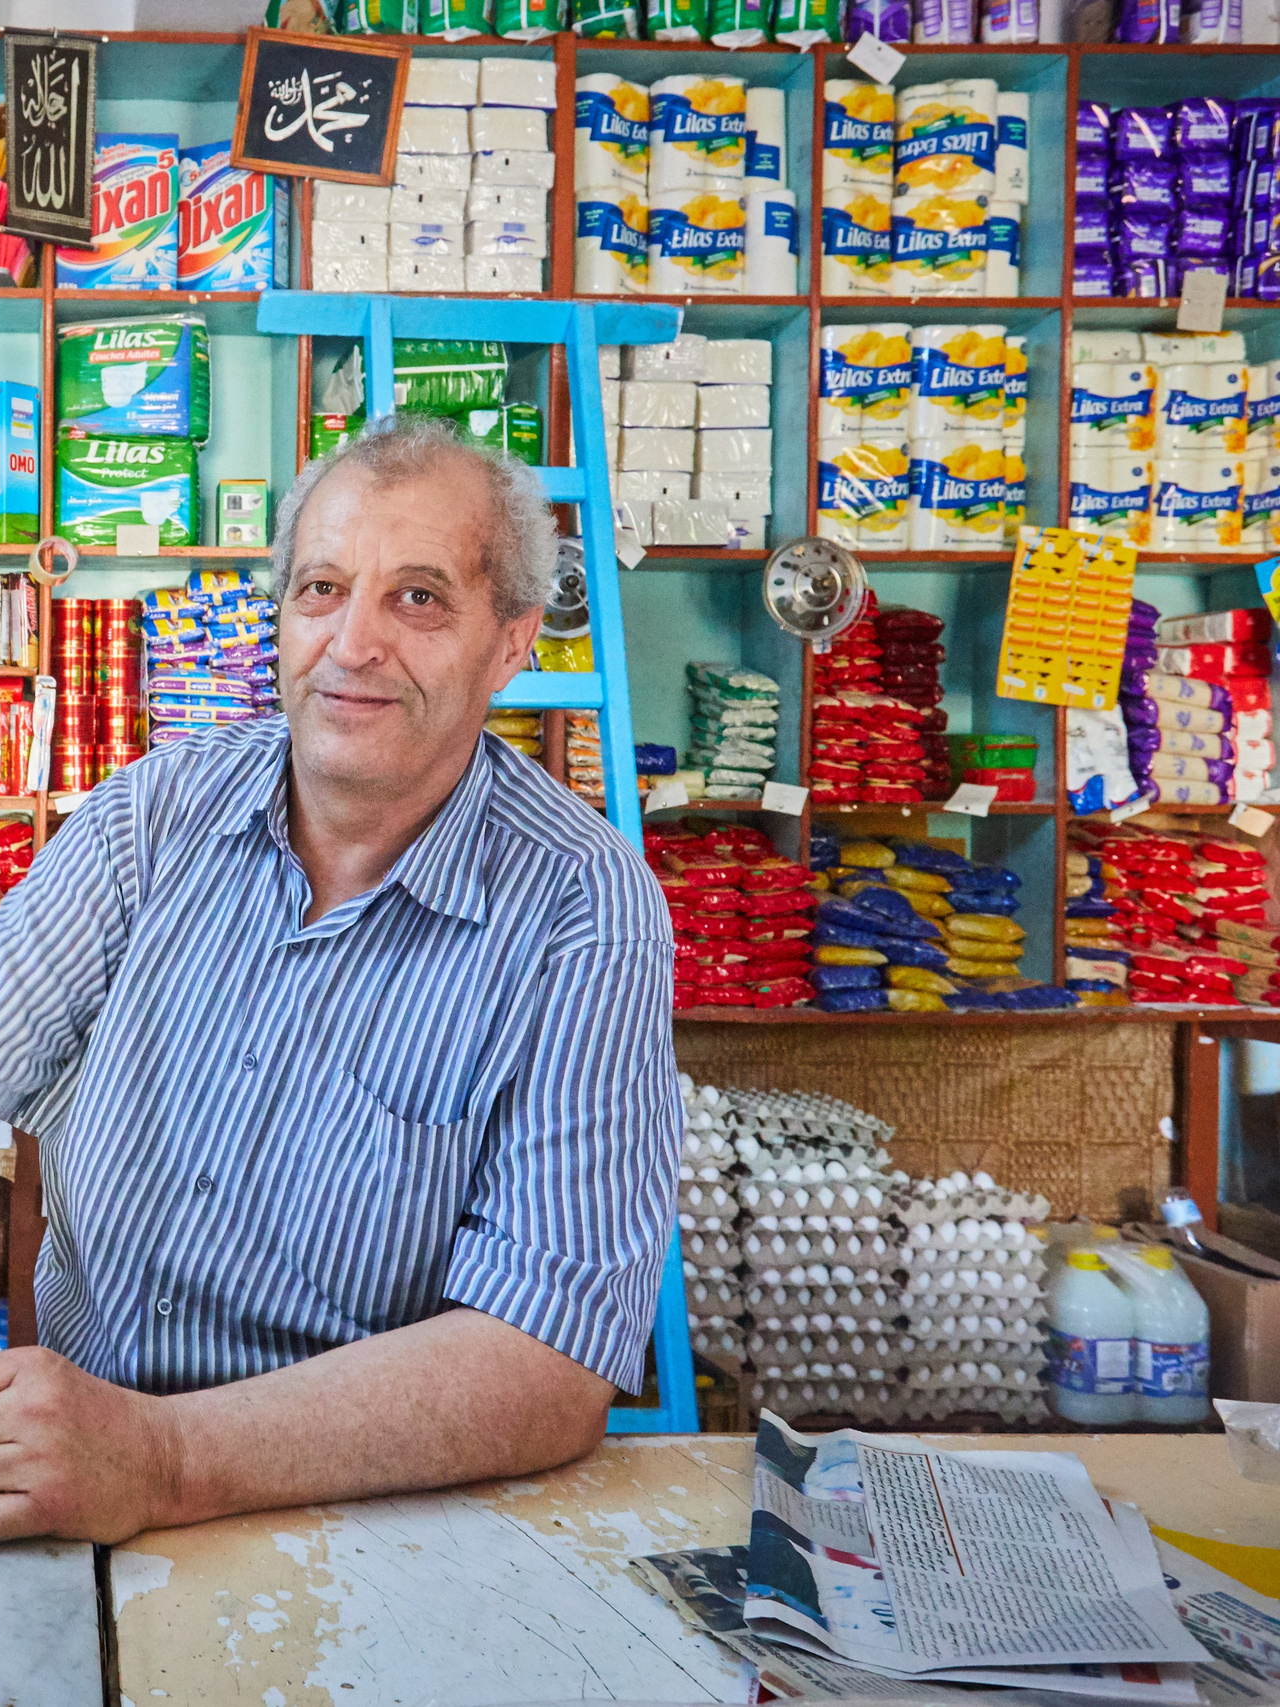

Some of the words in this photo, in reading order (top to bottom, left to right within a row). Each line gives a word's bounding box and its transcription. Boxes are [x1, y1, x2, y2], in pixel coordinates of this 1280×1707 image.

[601, 113, 631, 136] Lilas
[674, 113, 716, 134] Lilas
[830, 120, 869, 141] Lilas
[942, 131, 988, 152] Lilas
[157, 149, 175, 169] 5
[93, 171, 170, 237] ixan
[612, 224, 639, 246] Lilas
[671, 228, 713, 249] Lilas
[836, 227, 872, 248] Lilas
[897, 231, 943, 254] Lilas
[947, 232, 987, 249] Extra
[94, 329, 156, 350] Lilas
[89, 351, 125, 361] Couches
[127, 349, 161, 359] Adultes
[931, 367, 974, 389] Lilas
[978, 370, 1005, 386] Extr
[1072, 398, 1107, 417] Lilas
[1110, 400, 1143, 413] Extra
[1170, 399, 1207, 418] Lilas
[1209, 402, 1238, 415] Extra
[85, 440, 166, 464] Lilas
[9, 453, 35, 474] OMO
[101, 468, 149, 479] Protect
[932, 477, 974, 501] Lilas
[978, 481, 1005, 498] Extr
[1072, 495, 1108, 512] Lilas
[1111, 496, 1144, 509] Extra
[1161, 494, 1198, 511] Lilas
[1201, 496, 1232, 509] Extra
